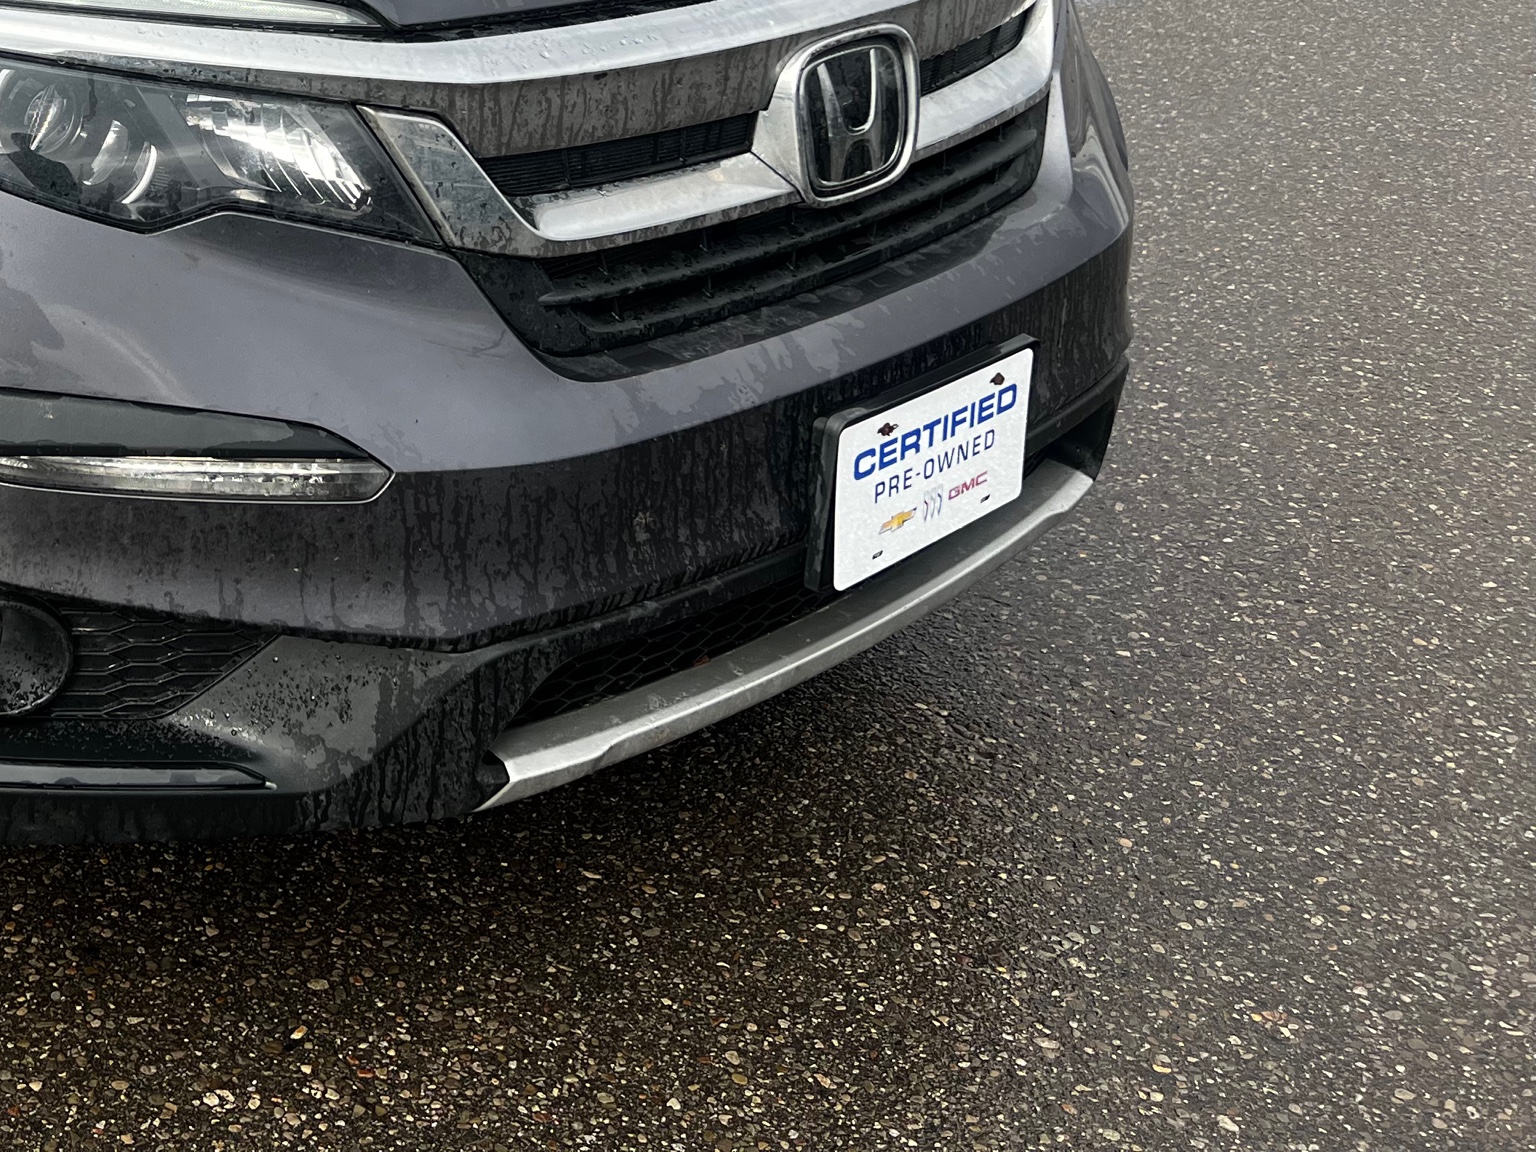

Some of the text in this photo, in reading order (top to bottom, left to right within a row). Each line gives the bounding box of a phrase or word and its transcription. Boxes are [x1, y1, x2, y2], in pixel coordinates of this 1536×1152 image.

[853, 384, 1018, 481] CERTIFIED
[874, 429, 995, 504] PRE-OWNED
[948, 471, 989, 500] GMC
